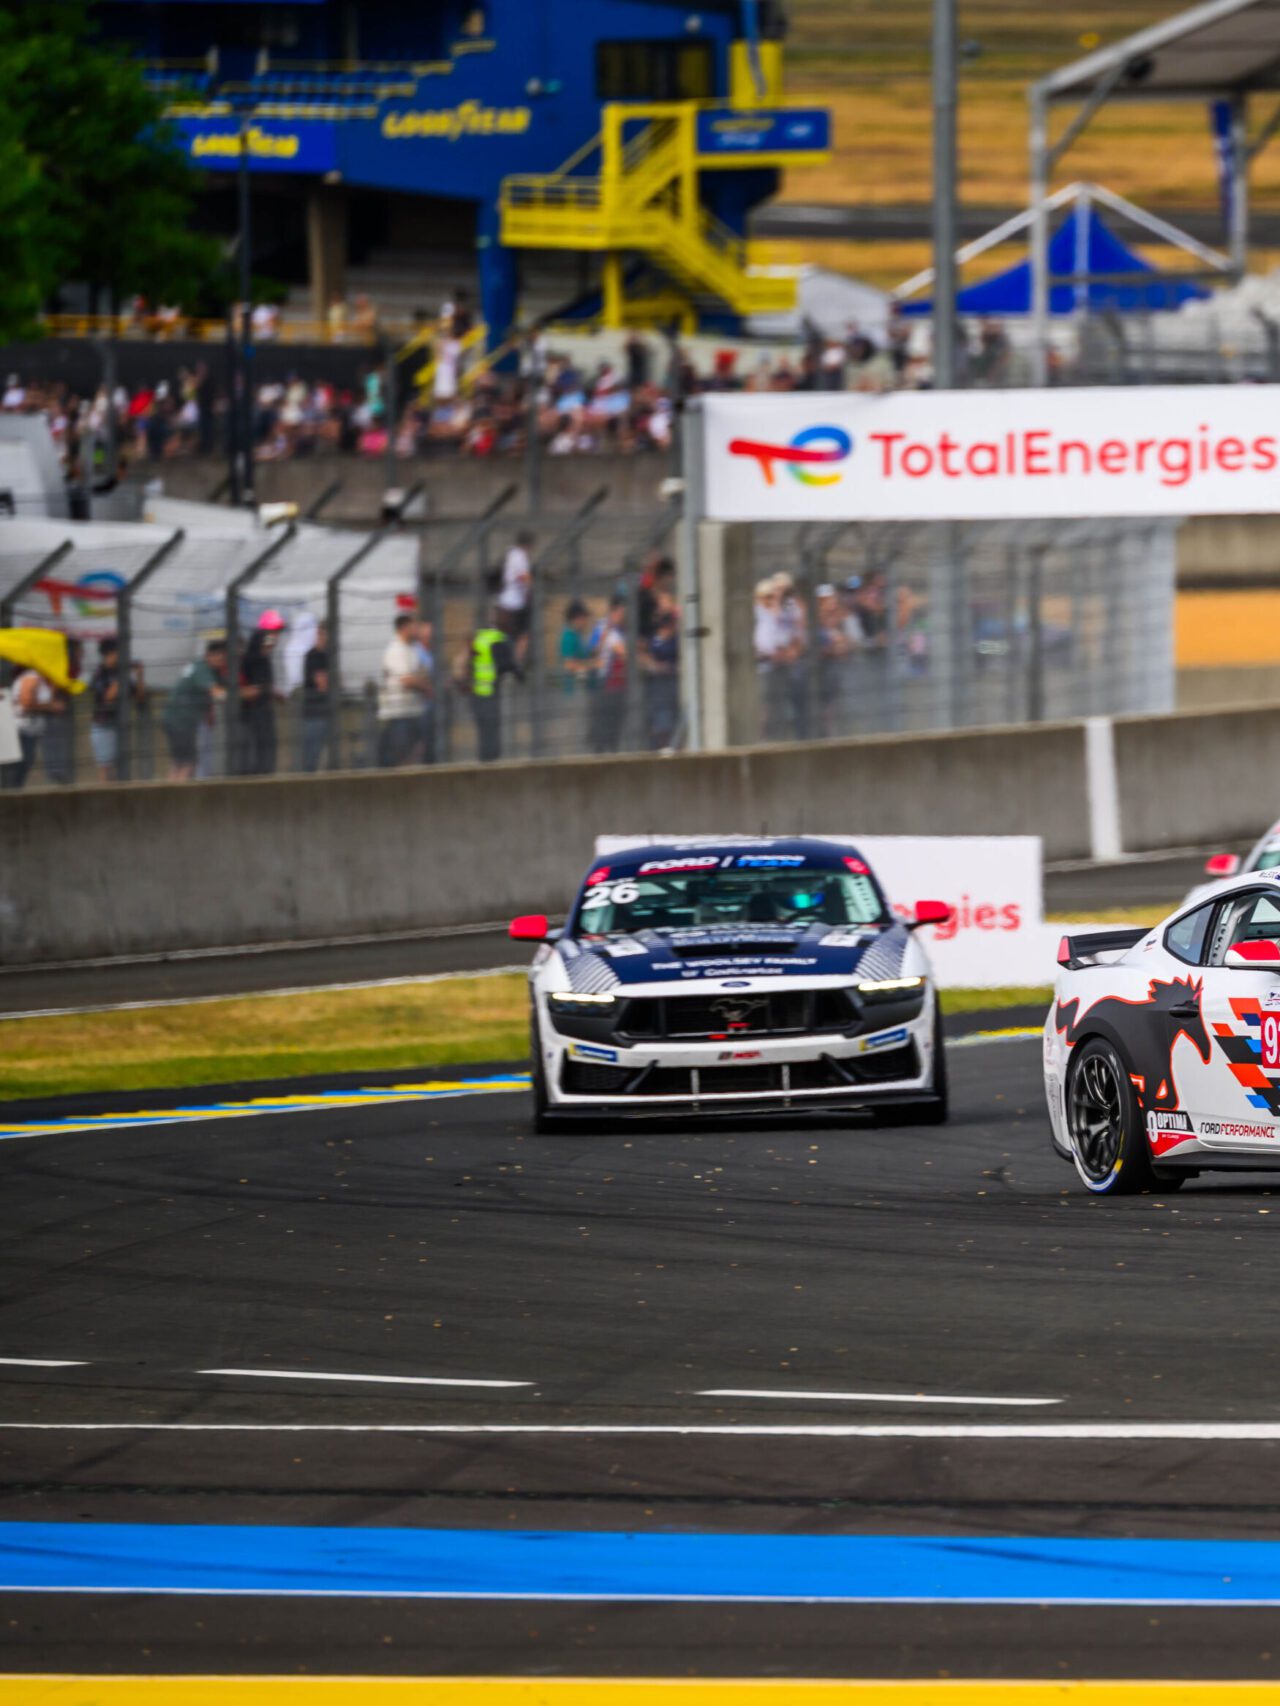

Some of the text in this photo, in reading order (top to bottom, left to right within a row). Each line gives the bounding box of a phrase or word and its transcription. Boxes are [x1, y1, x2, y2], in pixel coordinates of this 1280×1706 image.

[869, 424, 1278, 487] TotalEnergies
[639, 856, 720, 872] FORD
[582, 882, 640, 910] 26
[652, 960, 682, 970] THE
[764, 957, 818, 966] FAMILY
[1157, 1112, 1187, 1130] OPTIMA
